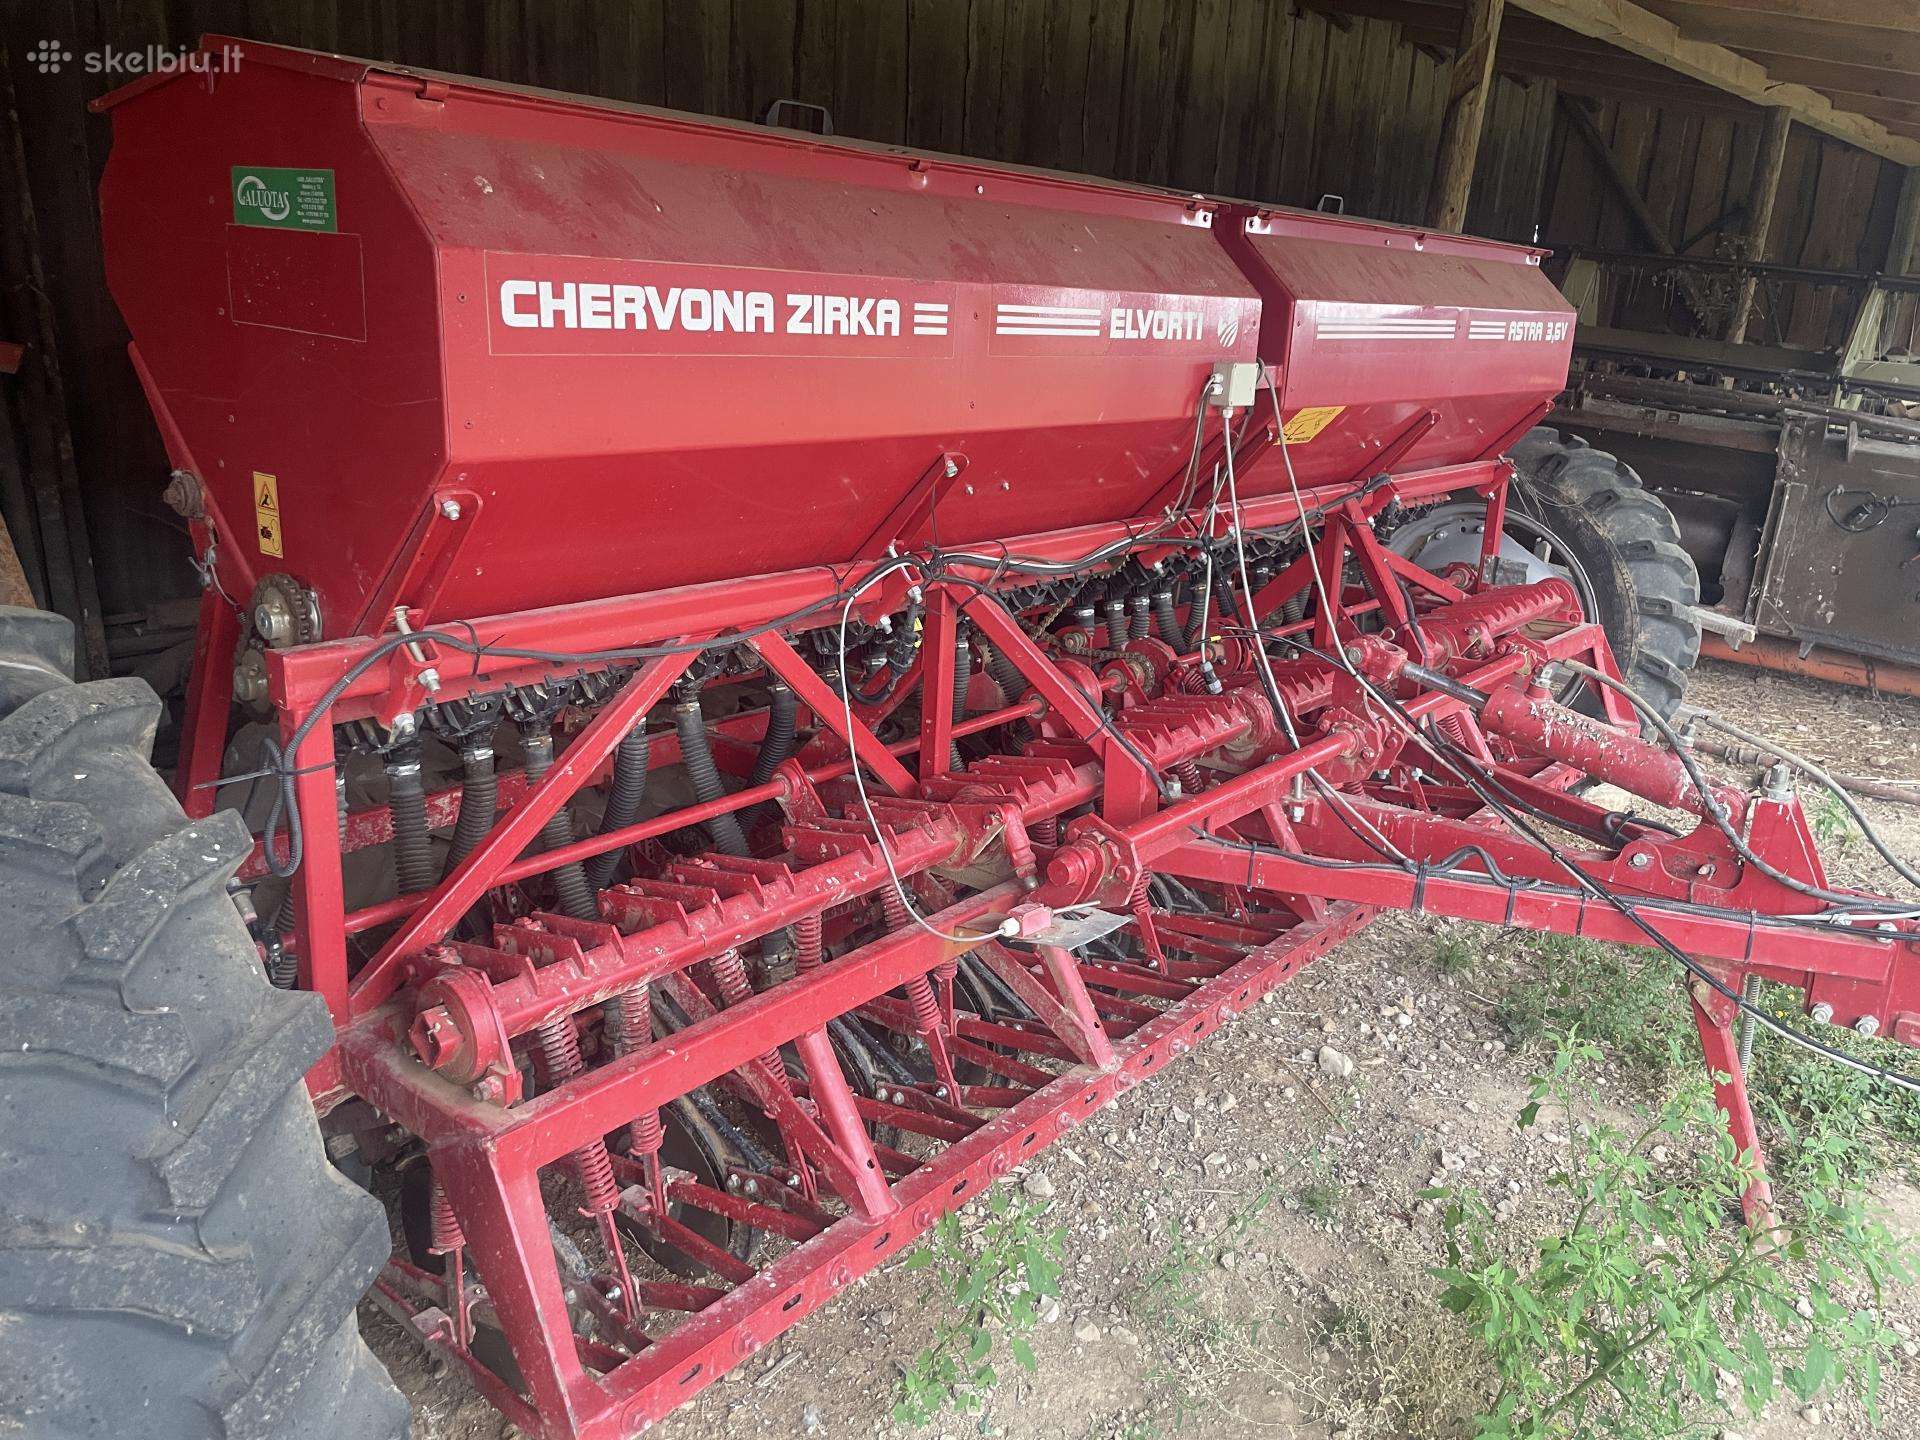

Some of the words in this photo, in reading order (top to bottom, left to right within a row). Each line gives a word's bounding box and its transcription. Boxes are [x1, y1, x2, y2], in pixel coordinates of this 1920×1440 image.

[238, 176, 290, 220] GALUOTAS
[500, 280, 774, 333] CHERVONA
[786, 294, 900, 336] ZIRKA
[1109, 308, 1204, 340] ELVORTI
[1508, 321, 1543, 341] ASTRA
